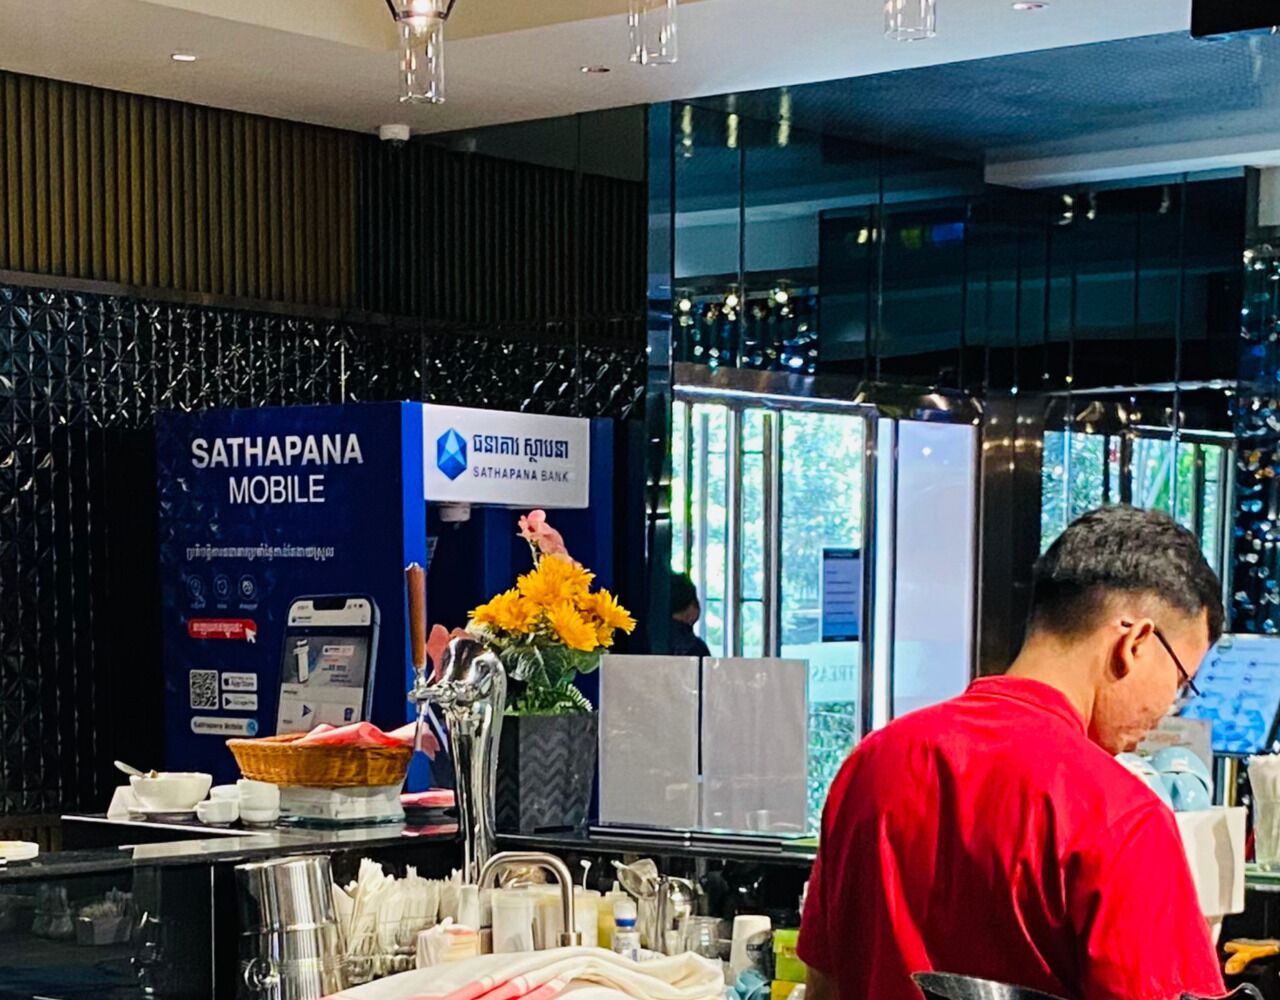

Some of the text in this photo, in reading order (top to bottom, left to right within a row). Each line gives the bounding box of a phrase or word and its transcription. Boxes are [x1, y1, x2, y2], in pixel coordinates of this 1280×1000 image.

[191, 433, 364, 469] SATHAPANA
[473, 466, 569, 482] SATHAPANA BANK
[229, 475, 325, 504] MOBILE
